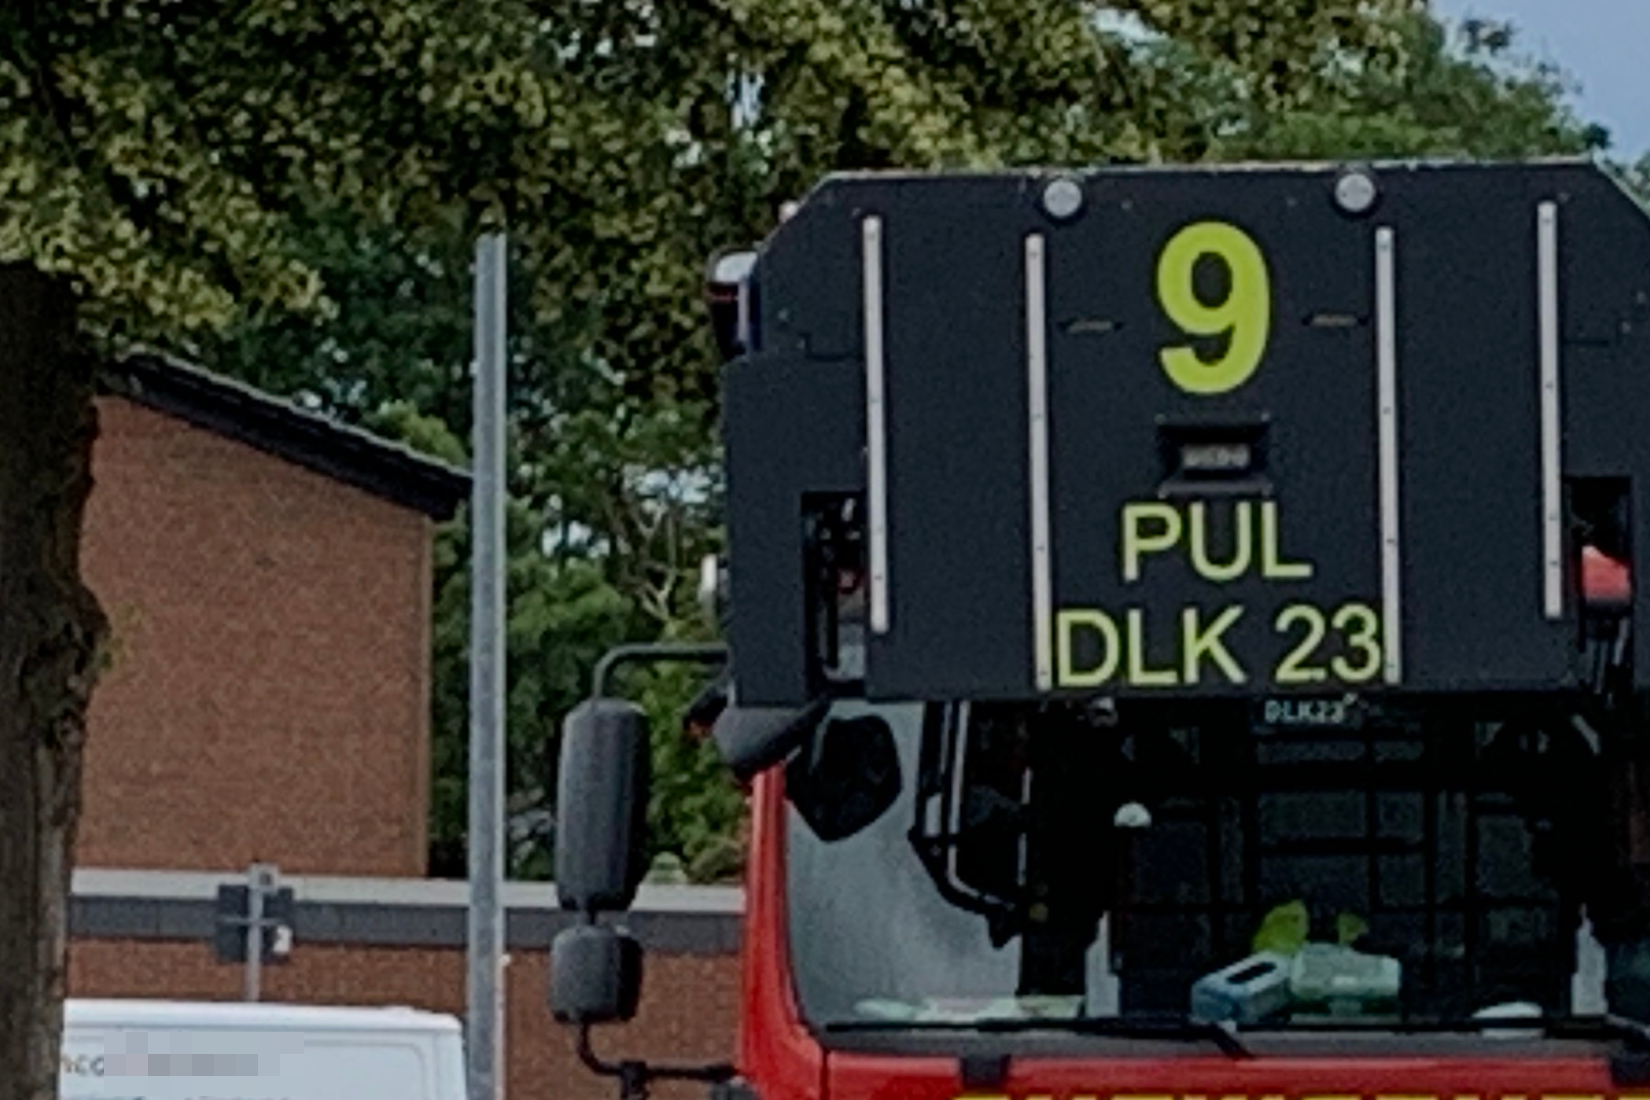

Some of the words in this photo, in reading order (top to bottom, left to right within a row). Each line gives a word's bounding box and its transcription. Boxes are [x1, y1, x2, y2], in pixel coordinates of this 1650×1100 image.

[1156, 222, 1271, 394] 9
[1120, 502, 1312, 582] PUL
[1056, 608, 1246, 688] DLK
[1276, 604, 1381, 684] 23
